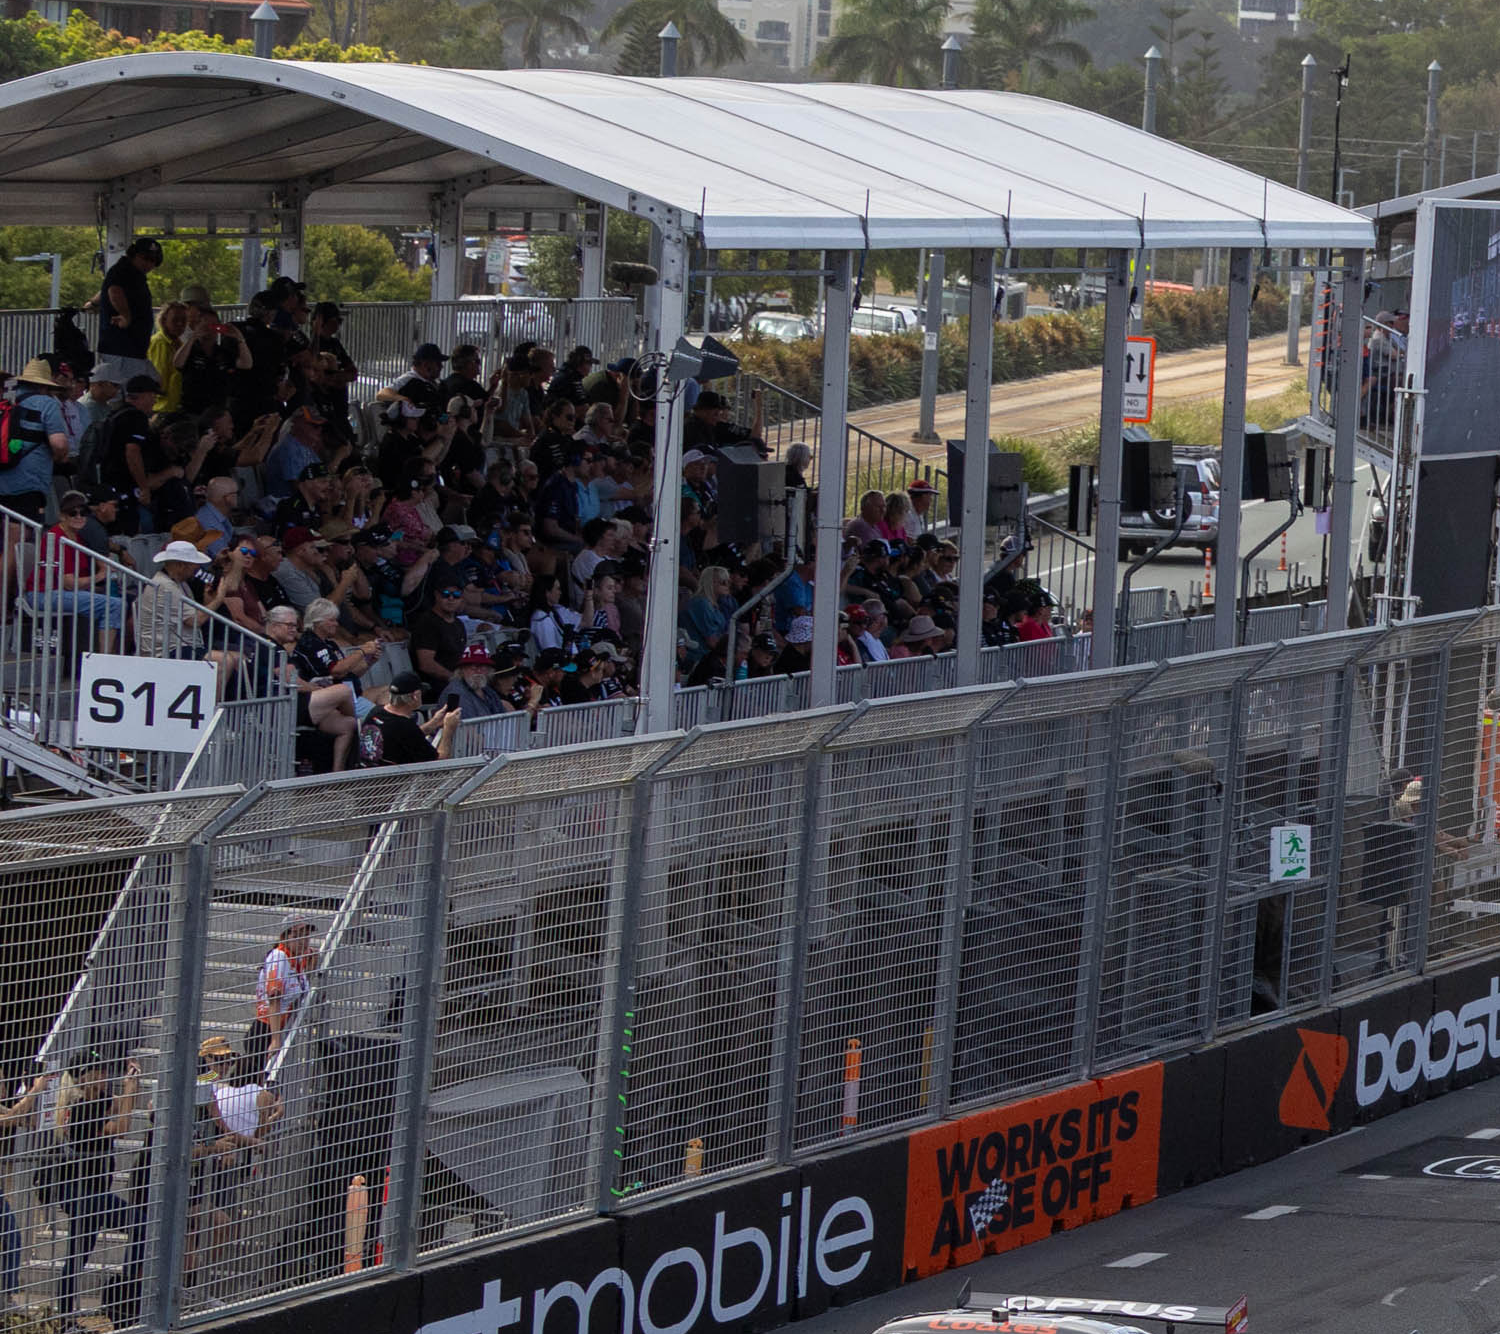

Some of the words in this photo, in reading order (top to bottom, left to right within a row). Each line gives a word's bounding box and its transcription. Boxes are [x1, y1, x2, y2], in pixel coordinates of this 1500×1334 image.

[89, 676, 206, 731] S14
[935, 1109, 1081, 1197] WORKS
[1084, 1089, 1140, 1153] ITS
[1039, 1149, 1112, 1216] OFF
[1002, 1295, 1200, 1322] OPTUS
